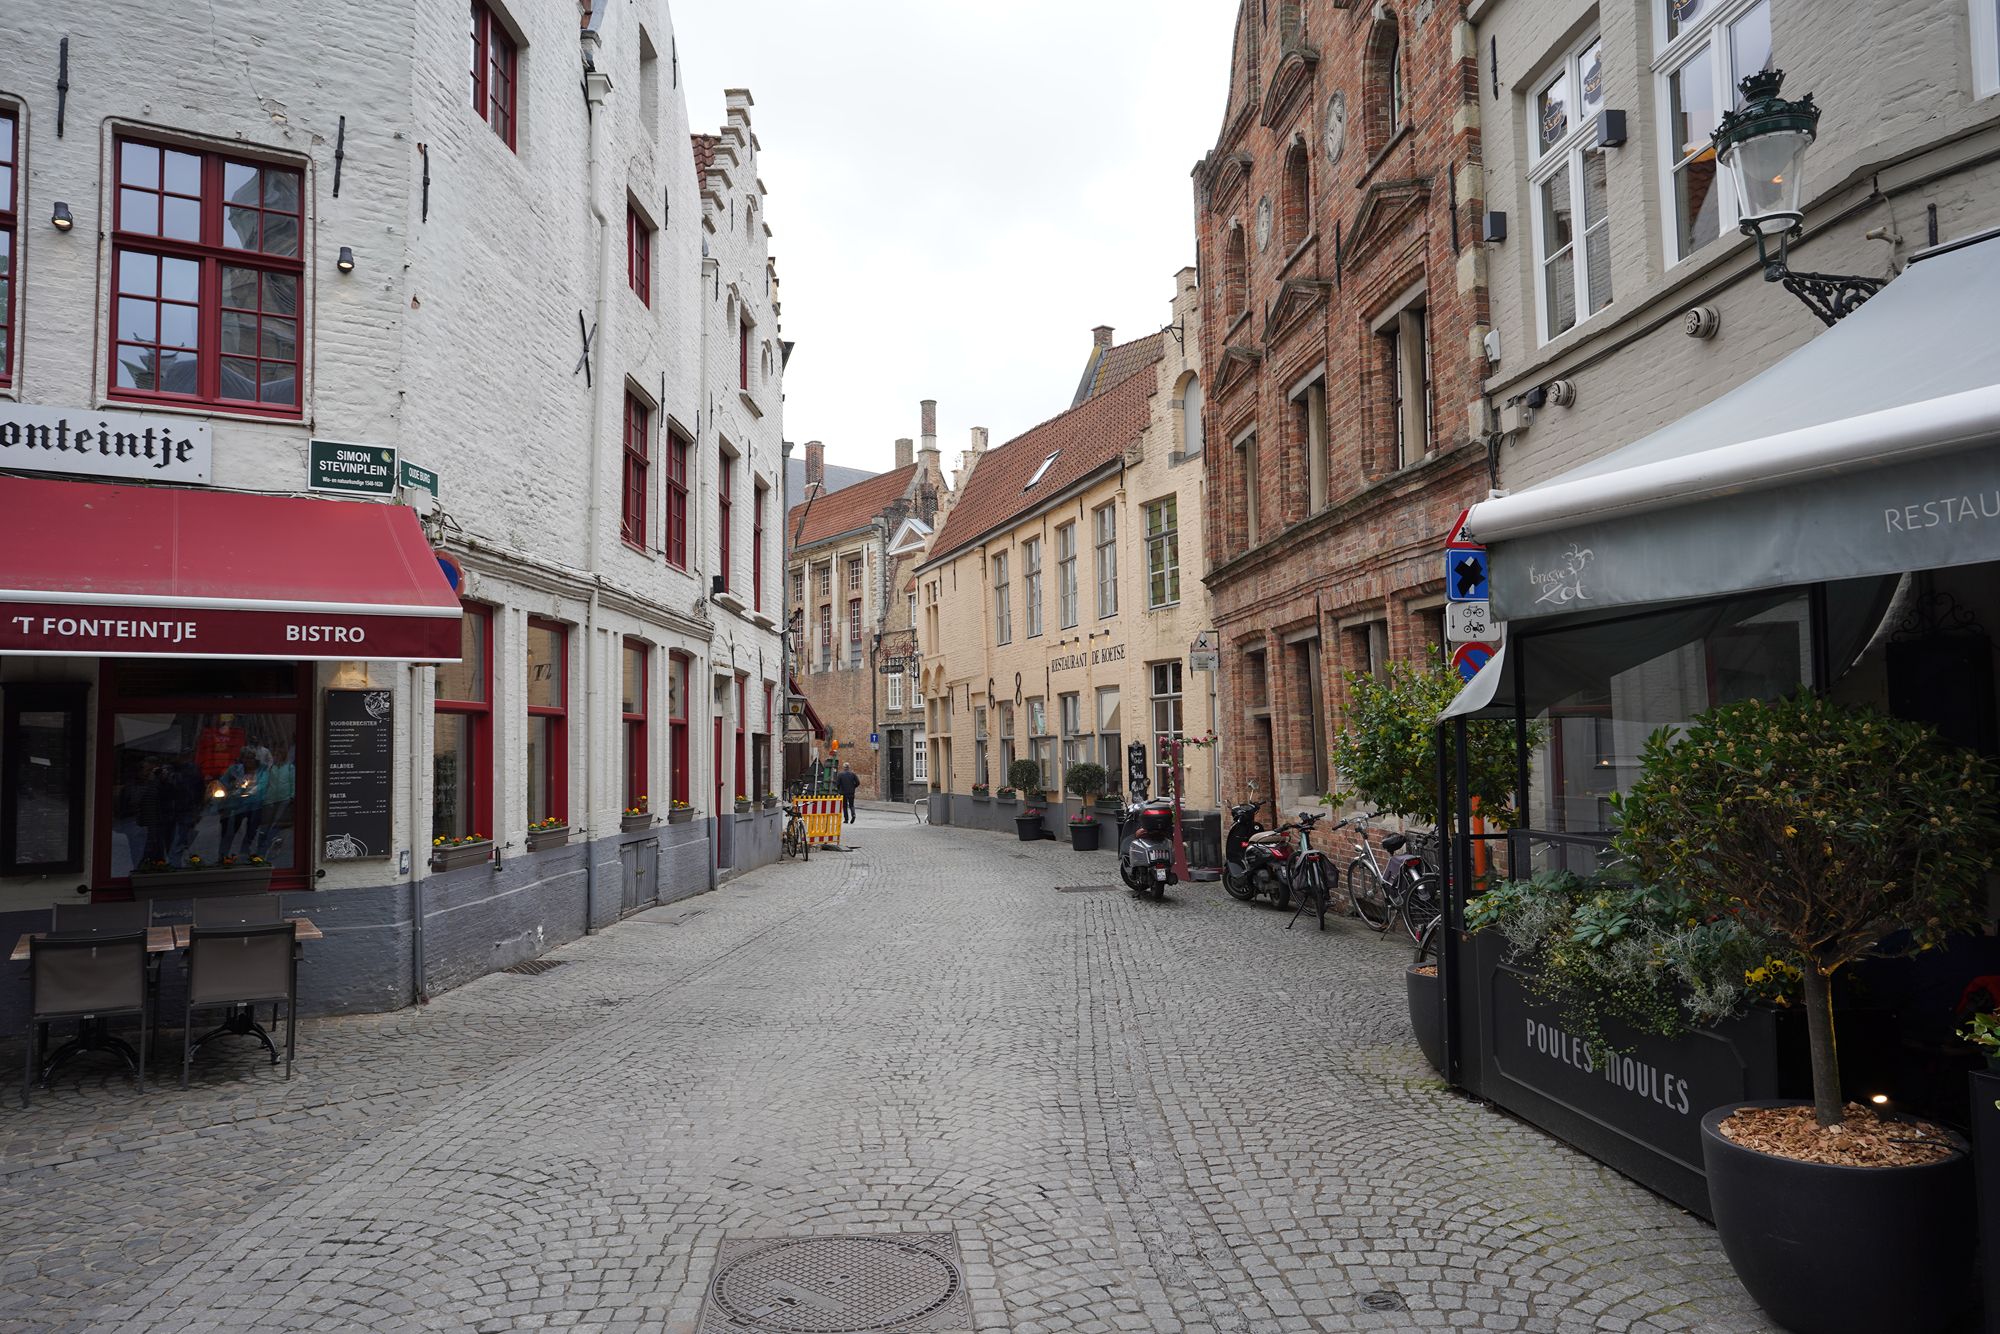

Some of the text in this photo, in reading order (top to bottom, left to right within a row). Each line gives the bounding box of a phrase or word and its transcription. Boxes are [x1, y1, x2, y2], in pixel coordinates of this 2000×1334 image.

[336, 450, 371, 463] SIMON
[320, 460, 387, 476] STEVINPLEIN
[408, 467, 431, 484] OUDE BURG
[1884, 490, 2000, 533] RESTAU
[43, 617, 197, 643] FONTEINTJE
[286, 625, 365, 643] BISTRO
[1051, 652, 1087, 673] RESTAURANT
[1091, 649, 1100, 665] DE
[1526, 1018, 1594, 1074] POULES
